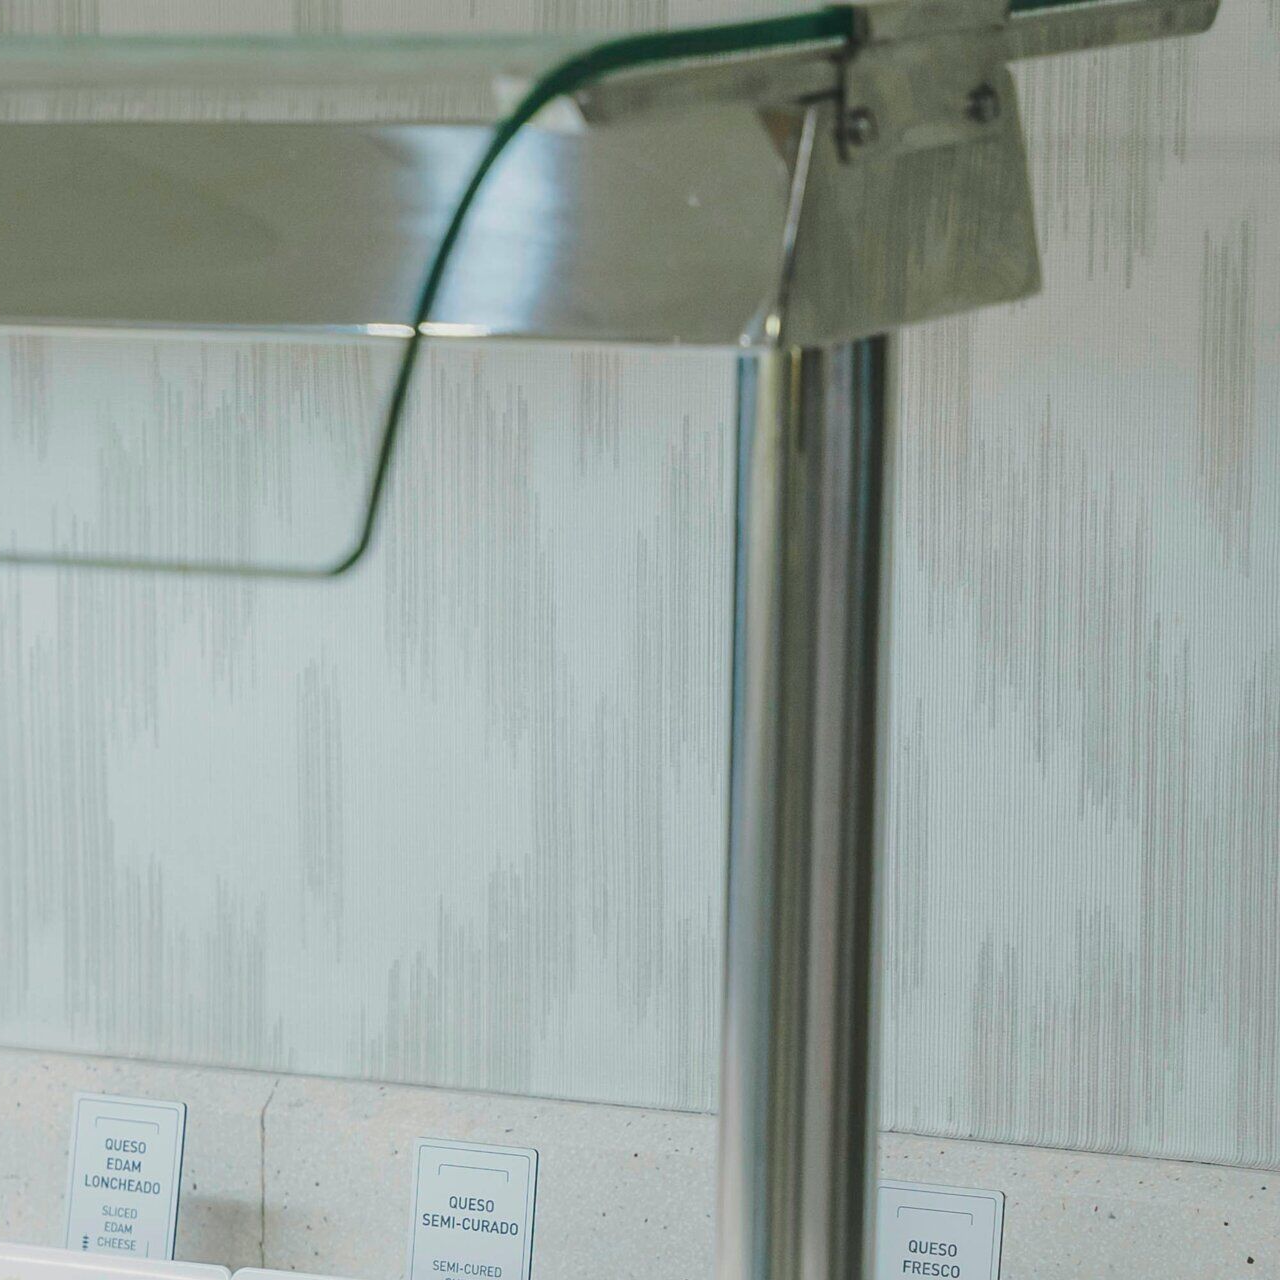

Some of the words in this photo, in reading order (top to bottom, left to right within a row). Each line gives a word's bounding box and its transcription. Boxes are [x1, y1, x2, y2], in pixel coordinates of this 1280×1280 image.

[105, 1138, 147, 1154] QUESO
[106, 1157, 142, 1173] EDAM
[84, 1174, 161, 1195] LONCHEADO
[102, 1205, 138, 1219] SLICED
[449, 1196, 495, 1213] QUESO
[104, 1221, 133, 1234] EDAM
[422, 1213, 519, 1236] SEMI-CURADO
[97, 1236, 136, 1251] CHEESE
[908, 1239, 958, 1257] QUESO
[432, 1260, 502, 1278] SEMI-CURED
[902, 1260, 960, 1278] FRESCO
